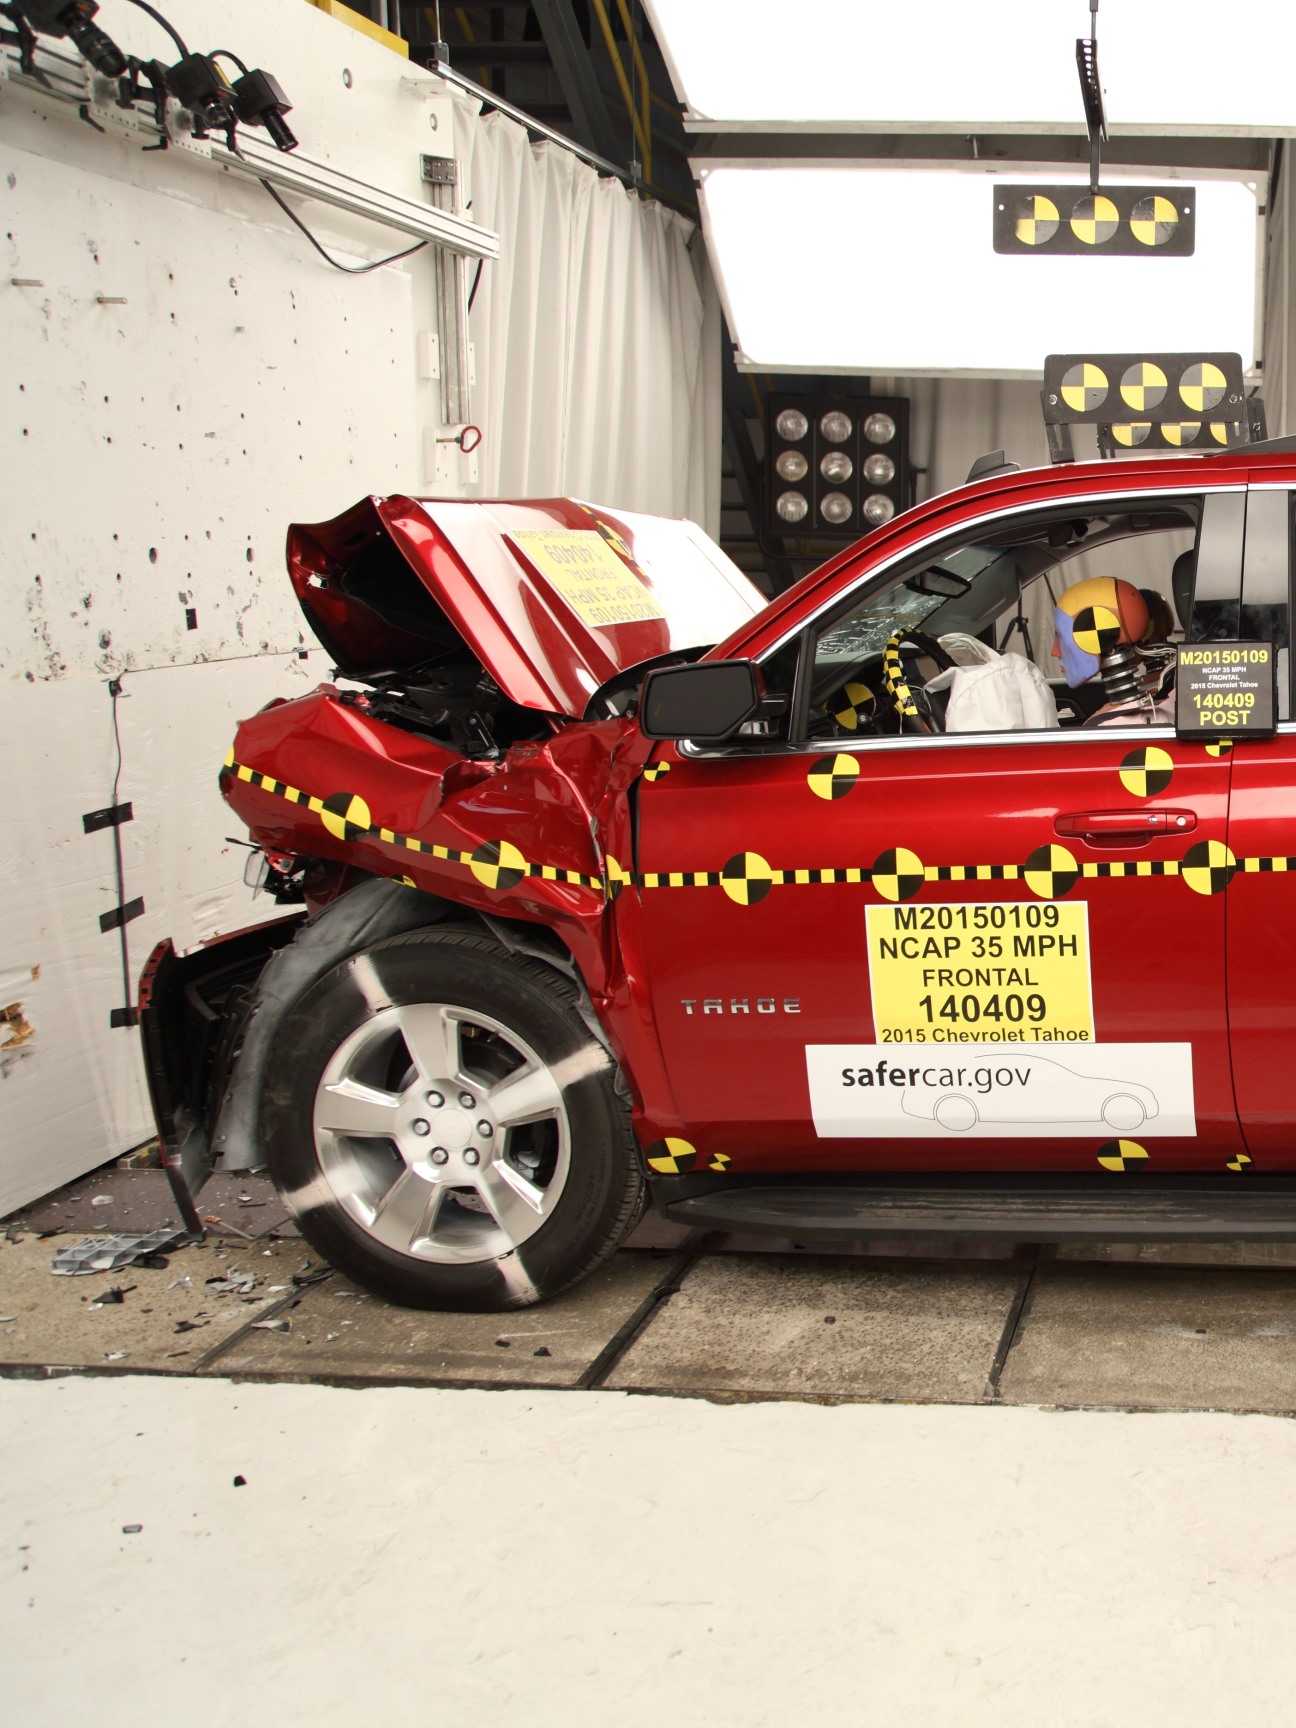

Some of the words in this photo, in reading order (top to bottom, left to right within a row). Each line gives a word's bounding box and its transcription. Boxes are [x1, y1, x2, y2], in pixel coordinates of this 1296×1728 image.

[543, 545, 603, 564] 140409
[564, 568, 618, 581] FRONTAL
[564, 587, 602, 605] MPH
[595, 586, 617, 602] 35
[616, 585, 650, 601] NCAP
[588, 602, 661, 624] M20150109
[1180, 650, 1269, 665] M20150109
[1193, 693, 1255, 709] 140409
[1200, 710, 1251, 726] POST
[893, 904, 1061, 931] M20150109
[879, 936, 962, 960] NCAP
[971, 935, 1004, 959] 35
[1013, 934, 1079, 958] MPH
[922, 967, 1040, 988] FRONTAL
[680, 997, 802, 1016] TAHOE
[918, 993, 1047, 1024] 140409
[881, 1027, 926, 1044] 2015
[931, 1027, 1026, 1043] Chevrolet
[1030, 1026, 1090, 1043] Tahoe
[840, 1060, 1032, 1094] safercar.gov
